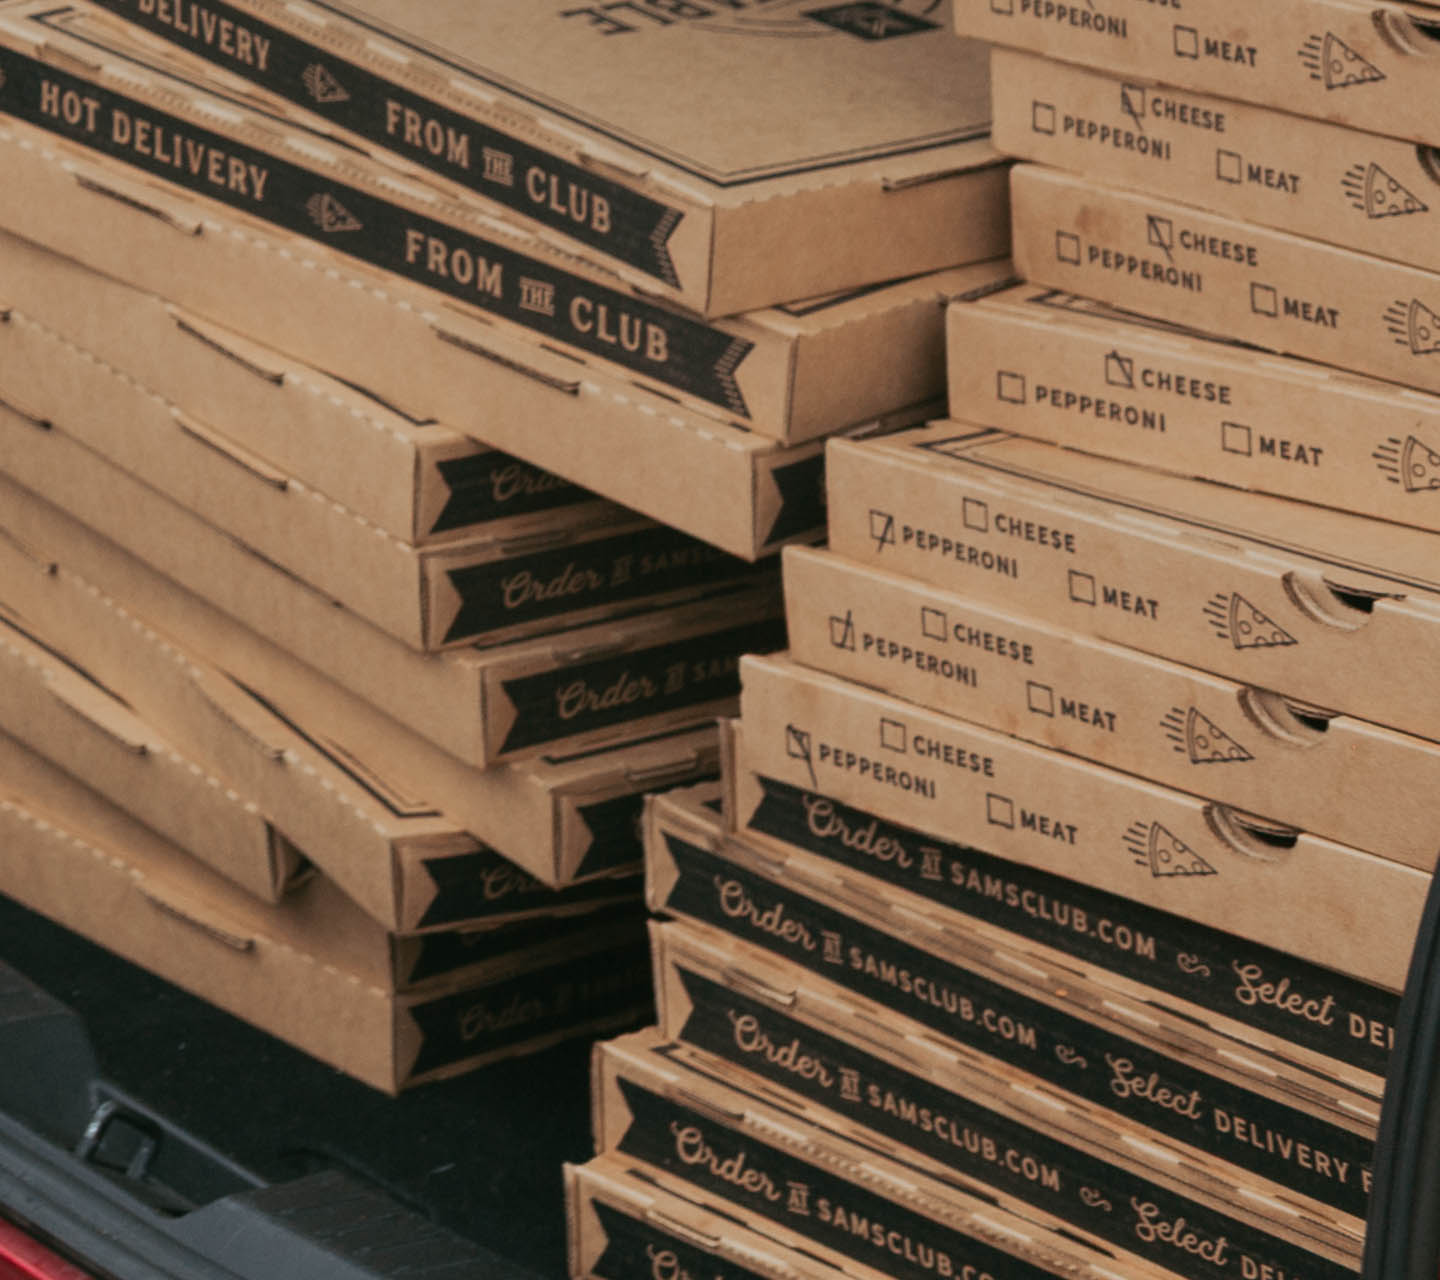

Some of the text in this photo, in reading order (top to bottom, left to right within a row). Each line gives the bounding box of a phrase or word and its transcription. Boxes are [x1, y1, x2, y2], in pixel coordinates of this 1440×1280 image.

[1203, 37, 1258, 68] MEAT
[1063, 115, 1301, 194] PEPPERONI MEAT
[1150, 97, 1226, 132] CHEESE
[385, 99, 470, 169] FROM
[482, 146, 515, 186] THE
[525, 165, 612, 234] CLUB
[40, 79, 670, 362] HOT DELIVERY FROM THE CLUB
[1179, 230, 1259, 267] CHEESE
[1088, 245, 1340, 329] PEPPERONI MEAT
[1035, 385, 1323, 467] PEPPERONI MEAT
[1141, 369, 1232, 406] CHEESE
[902, 525, 1159, 620] PEPPERONI MEAT
[994, 512, 1077, 554] CHEESE
[500, 561, 604, 609] Order
[861, 633, 1117, 733] PEPPERONI MEAT
[953, 624, 1035, 665] CHEESE
[555, 671, 658, 722] Order
[818, 743, 1079, 845] PEPPERONI MEAT
[912, 735, 995, 778] CHEESE
[802, 792, 1336, 1026] Order AT SAMSCLUB.COM Select
[714, 873, 1351, 1184] Order AT SAMSCLUB.COM Select DELIVERY
[670, 1120, 781, 1202] Order
[785, 1180, 811, 1217] AT
[728, 1009, 1229, 1267] Order AT SAMSCLUB.COM Select
